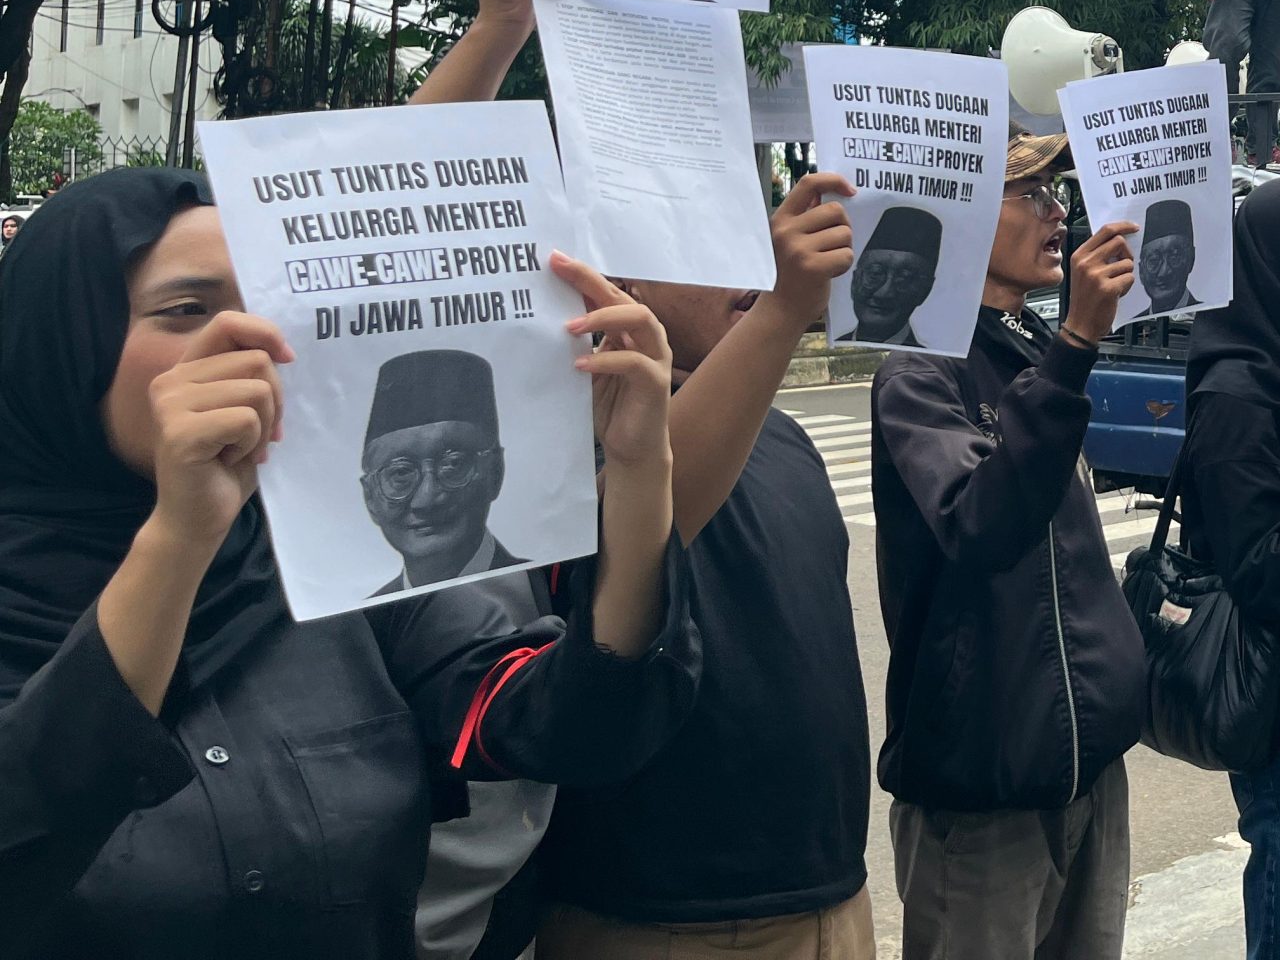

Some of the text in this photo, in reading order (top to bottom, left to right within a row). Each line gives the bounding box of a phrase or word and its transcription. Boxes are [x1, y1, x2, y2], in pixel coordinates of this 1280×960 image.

[833, 84, 988, 116] USUT TUNTAS DUGAAN
[1083, 93, 1210, 131] USUT TUNTAS DUGAAN
[845, 111, 981, 144] KELUARGA MENTERI
[1096, 118, 1207, 152] KELUARGA MENTERI
[843, 137, 983, 174] CAWE-CAWE PROYEK
[1098, 141, 1211, 177] CAWE-CAWE PROYEK
[253, 156, 528, 204] USUT TUNTAS DUGAAN
[855, 168, 973, 203] DI JAWA TIMUR !!!
[1113, 168, 1208, 198] DI JAWA TIMUR !!!
[282, 200, 526, 245] KELUARGA MENTERI
[285, 242, 540, 293] CAWE-CAWE PROYEK
[316, 288, 534, 340] DI JAWA TIMUR !!!
